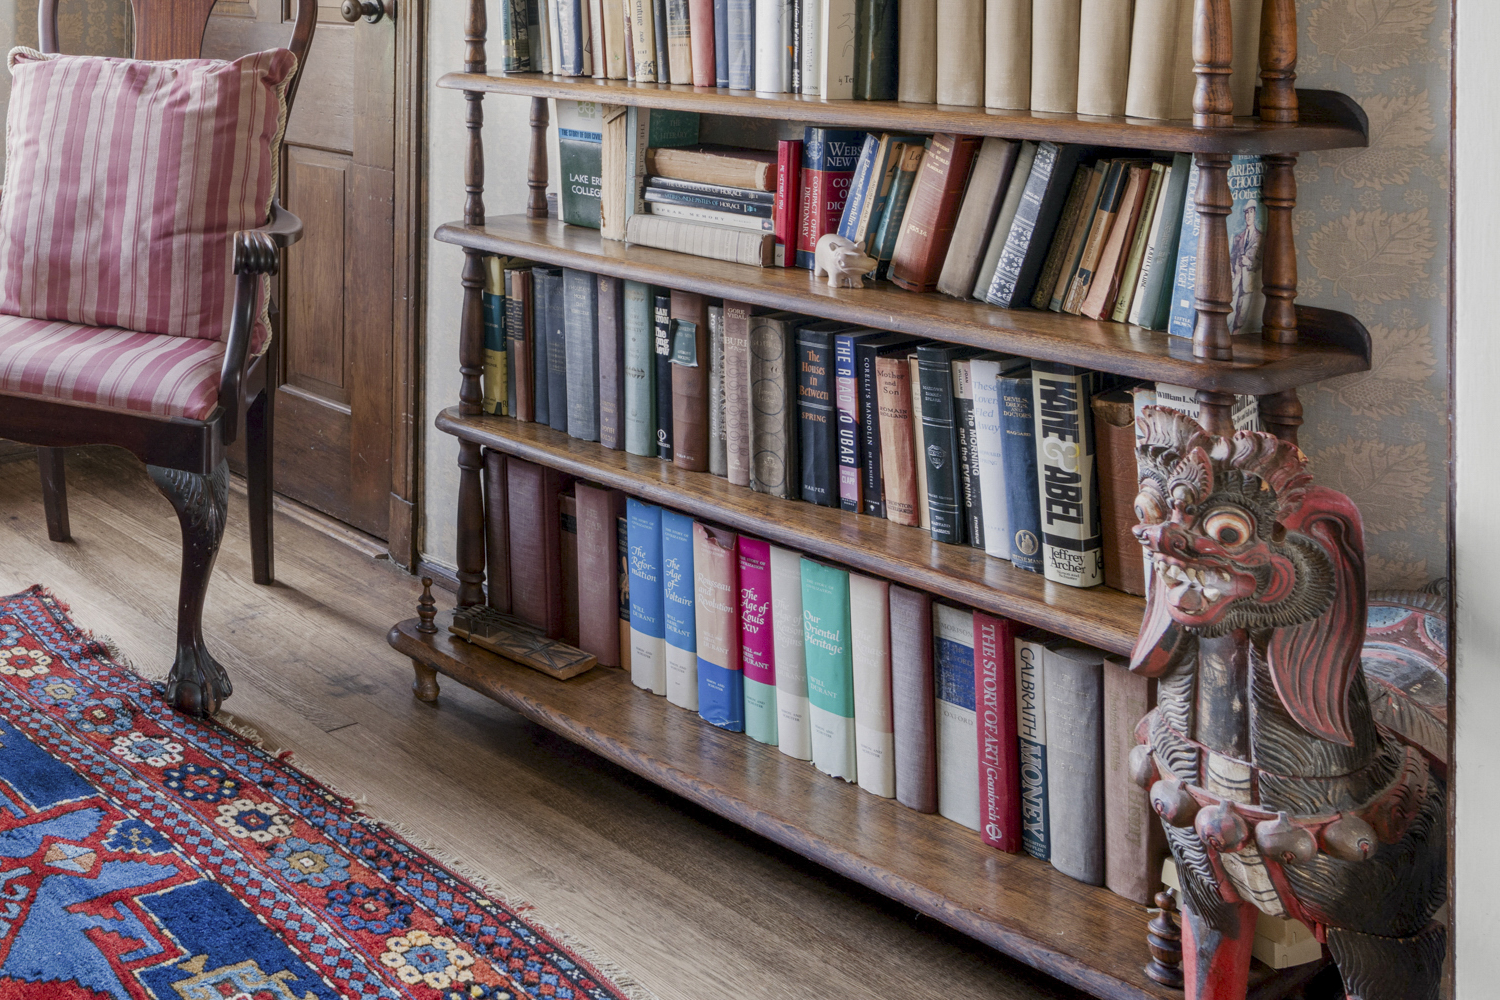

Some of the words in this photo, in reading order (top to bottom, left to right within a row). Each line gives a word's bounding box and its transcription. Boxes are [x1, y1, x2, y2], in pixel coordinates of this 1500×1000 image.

[569, 129, 580, 138] STORY
[827, 156, 850, 167] NEW
[569, 173, 589, 184] LAKE
[858, 159, 871, 189] Eleanor
[572, 185, 602, 199] COLLEG
[719, 188, 742, 198] HORACE
[811, 176, 819, 215] COMPACT
[1184, 169, 1199, 225] SCHOOLDAYS
[1238, 190, 1257, 200] Other
[718, 200, 740, 210] HORACE
[802, 186, 811, 238] DICTIONARY
[848, 190, 862, 226] Franklin
[809, 219, 817, 247] OFFICE
[1178, 255, 1189, 287] WAUGH
[1188, 256, 1196, 290] EVELYN
[727, 312, 747, 321] VIDAL
[728, 307, 745, 315] GORE
[807, 350, 820, 363] The
[836, 339, 851, 363] THE
[802, 362, 826, 376] Houses
[877, 370, 905, 380] Mother
[809, 375, 818, 386] in
[837, 366, 852, 402] ROAD
[862, 356, 871, 399] CORELLI'S
[800, 385, 829, 401] Between
[883, 387, 900, 396] Son
[973, 381, 998, 392] These
[1156, 391, 1182, 402] William
[802, 412, 827, 424] SPRING
[838, 407, 853, 424] TO
[879, 406, 908, 415] ROMAIN
[880, 411, 908, 420] ROLLAND
[975, 408, 994, 418] Fled
[1003, 411, 1032, 419] DOCTORS
[1039, 378, 1079, 444] KANE
[864, 401, 873, 446] MANDOLIN
[976, 421, 1000, 435] Away
[839, 428, 854, 464] UBAR
[969, 430, 980, 476] MORNING
[867, 450, 872, 458] DE
[1043, 437, 1080, 473] &
[841, 475, 856, 486] CLAPP
[963, 463, 973, 508] EVENING
[804, 484, 826, 494] HARPER
[1044, 464, 1084, 525] ABEL
[972, 514, 980, 545] ATHENEUM
[630, 545, 646, 559] The
[1050, 547, 1085, 568] Jeffrey
[630, 556, 656, 572] Refor-
[665, 558, 681, 571] The
[1050, 558, 1086, 574] Archer
[631, 568, 657, 582] mation
[666, 569, 682, 582] Age
[698, 573, 732, 592] Rousseau
[667, 580, 680, 590] of
[698, 586, 713, 596] and
[665, 588, 693, 607] Voltaire
[741, 588, 758, 601] The
[633, 603, 645, 613] WILL
[698, 595, 734, 614] Revolution
[741, 598, 757, 612] Age
[758, 601, 770, 616] of
[775, 599, 790, 611] The
[633, 610, 656, 624] DURANT
[667, 613, 677, 622] WILL
[741, 610, 765, 626] Louis
[776, 609, 792, 623] Age
[804, 610, 821, 624] Our
[666, 623, 691, 638] DURANT
[743, 622, 759, 634] XIV
[776, 620, 804, 637] Reason
[804, 621, 840, 642] Oriental
[941, 623, 974, 638] MORISON
[776, 632, 803, 648] Begins
[804, 632, 843, 656] Heritage
[980, 623, 995, 657] THE
[703, 641, 730, 655] DURANT
[742, 656, 770, 670] DURANT
[810, 676, 825, 688] WILL
[981, 658, 997, 713] STORY
[810, 683, 838, 699] DURANT
[1020, 647, 1037, 739] GALBRAITH
[944, 711, 974, 726] OXFORD
[983, 709, 997, 733] OF
[984, 729, 999, 765] ART
[985, 767, 999, 821] Gombrich
[1020, 740, 1044, 842] MONEY
